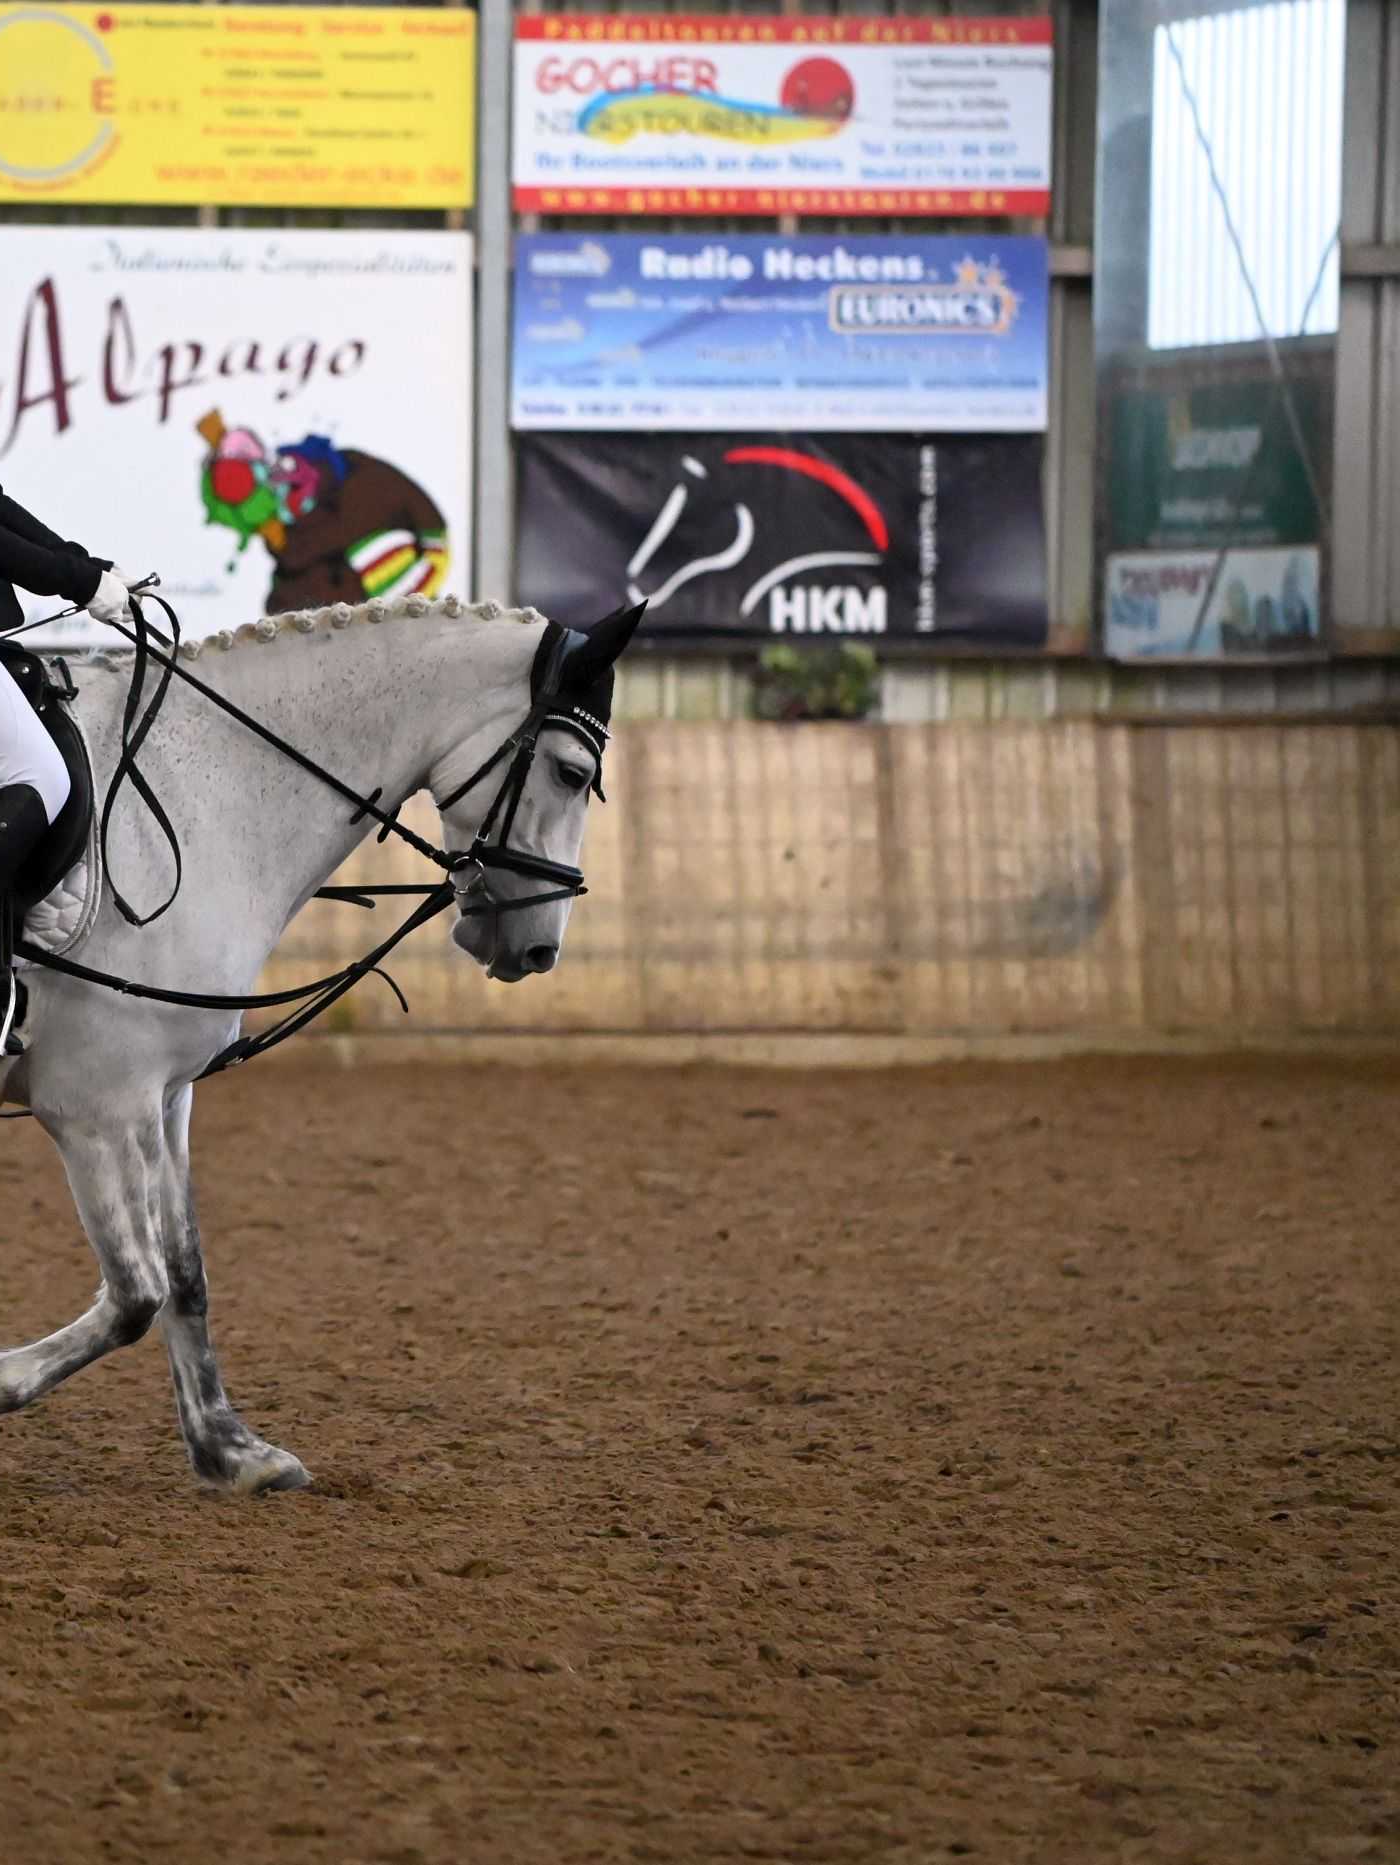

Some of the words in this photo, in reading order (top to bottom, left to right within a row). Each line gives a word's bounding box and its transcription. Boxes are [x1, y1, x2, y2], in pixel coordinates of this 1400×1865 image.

[535, 55, 719, 95] GOCHER
[639, 244, 754, 280] Radio
[763, 248, 924, 282] Heckens
[838, 291, 997, 327] EURONICS
[769, 586, 888, 633] HKM
